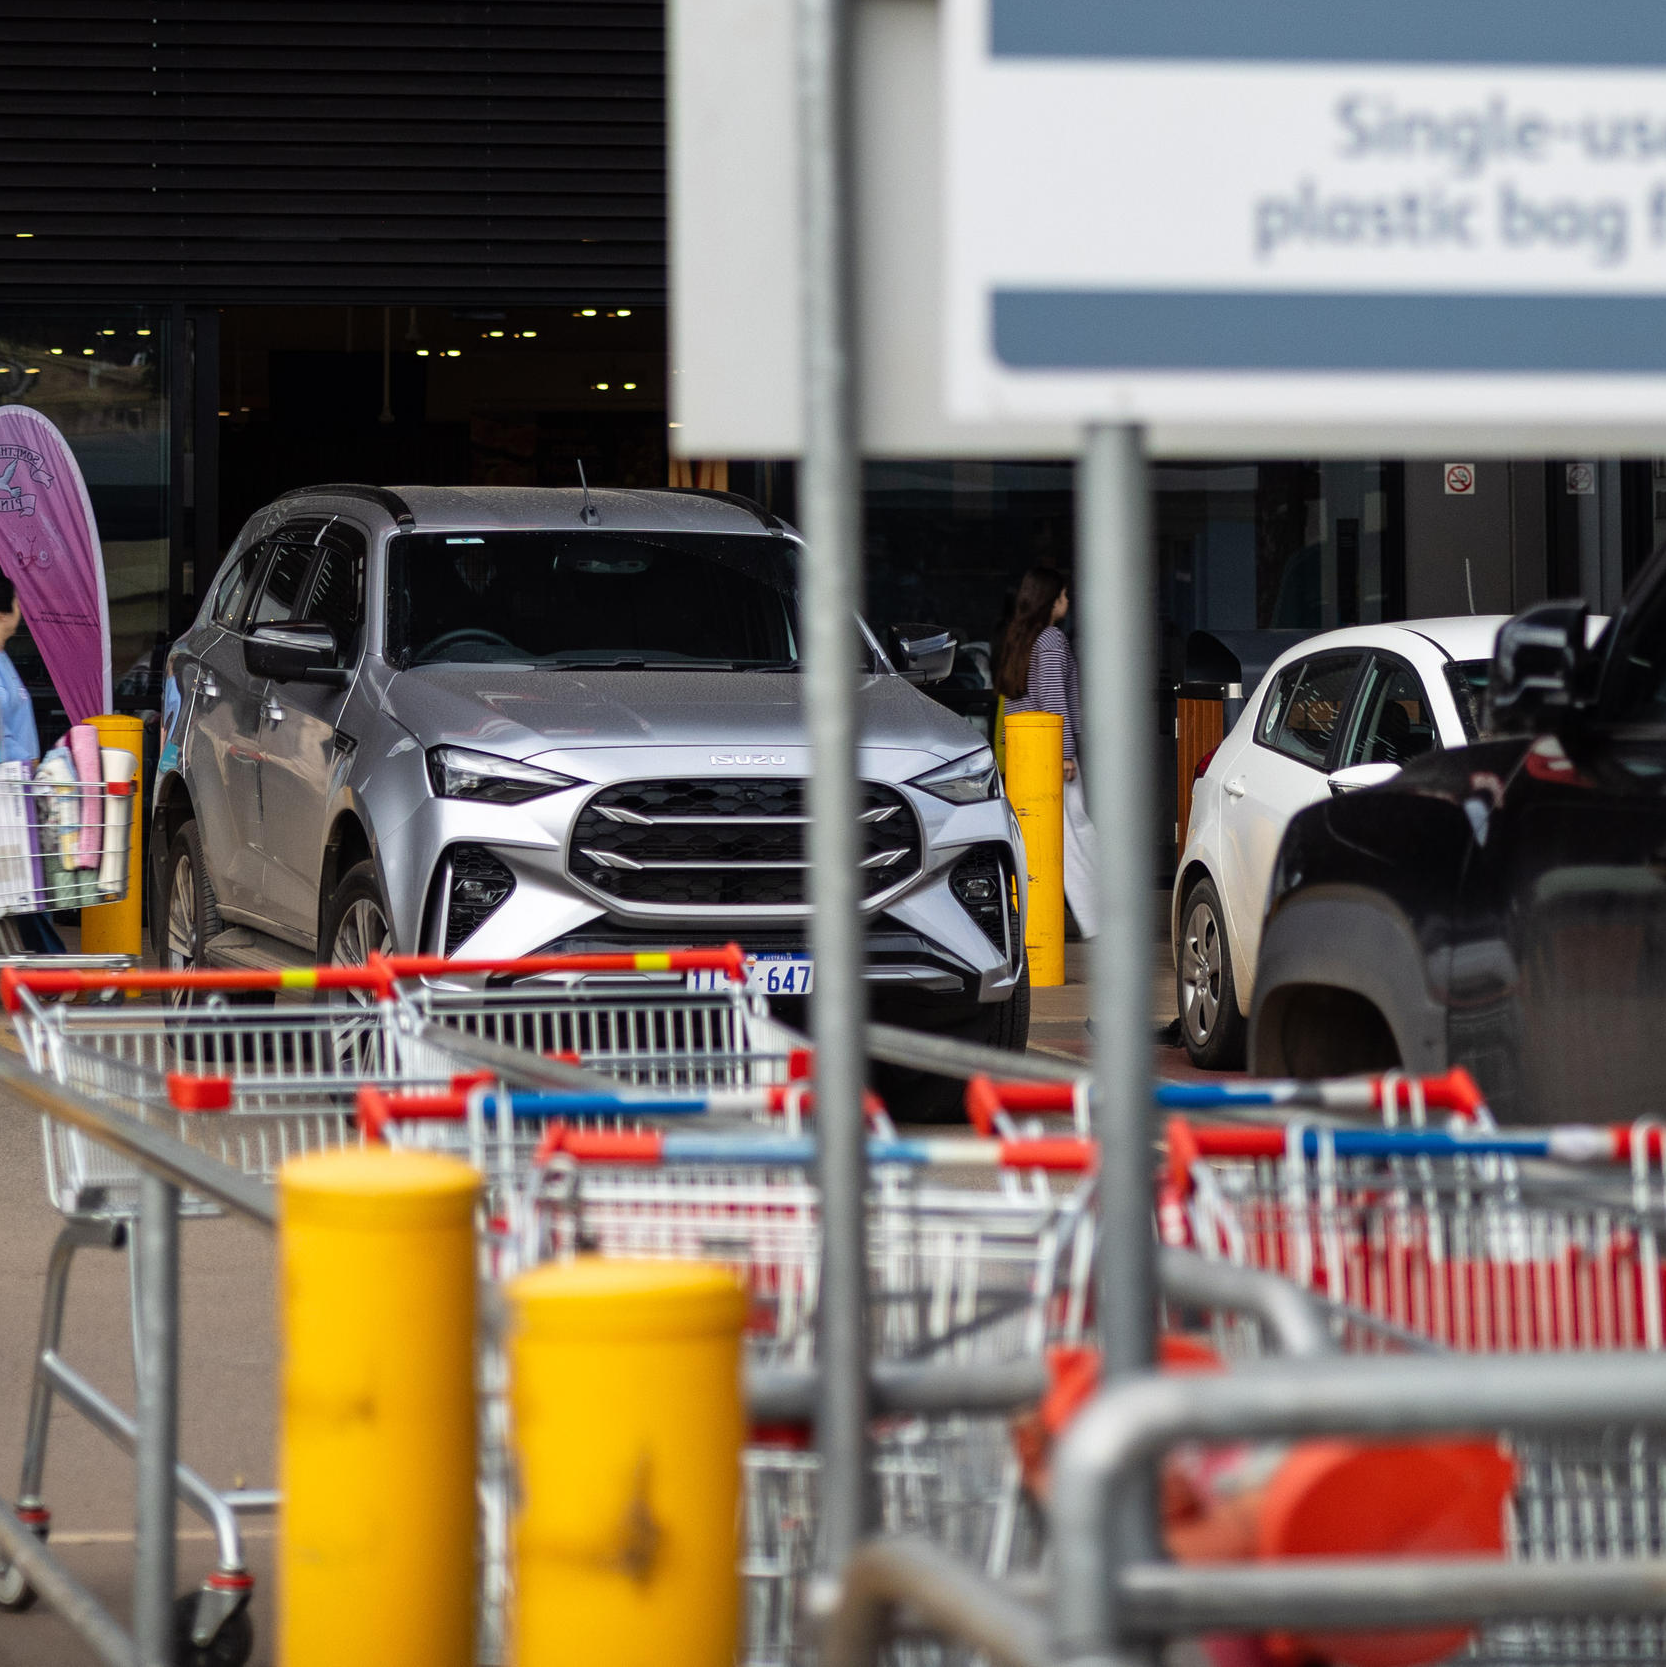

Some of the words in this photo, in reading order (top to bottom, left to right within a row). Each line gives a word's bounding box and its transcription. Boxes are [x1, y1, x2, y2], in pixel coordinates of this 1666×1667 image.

[1253, 178, 1479, 261] plastic
[1499, 178, 1630, 266] bag
[709, 754, 786, 766] ISUZU
